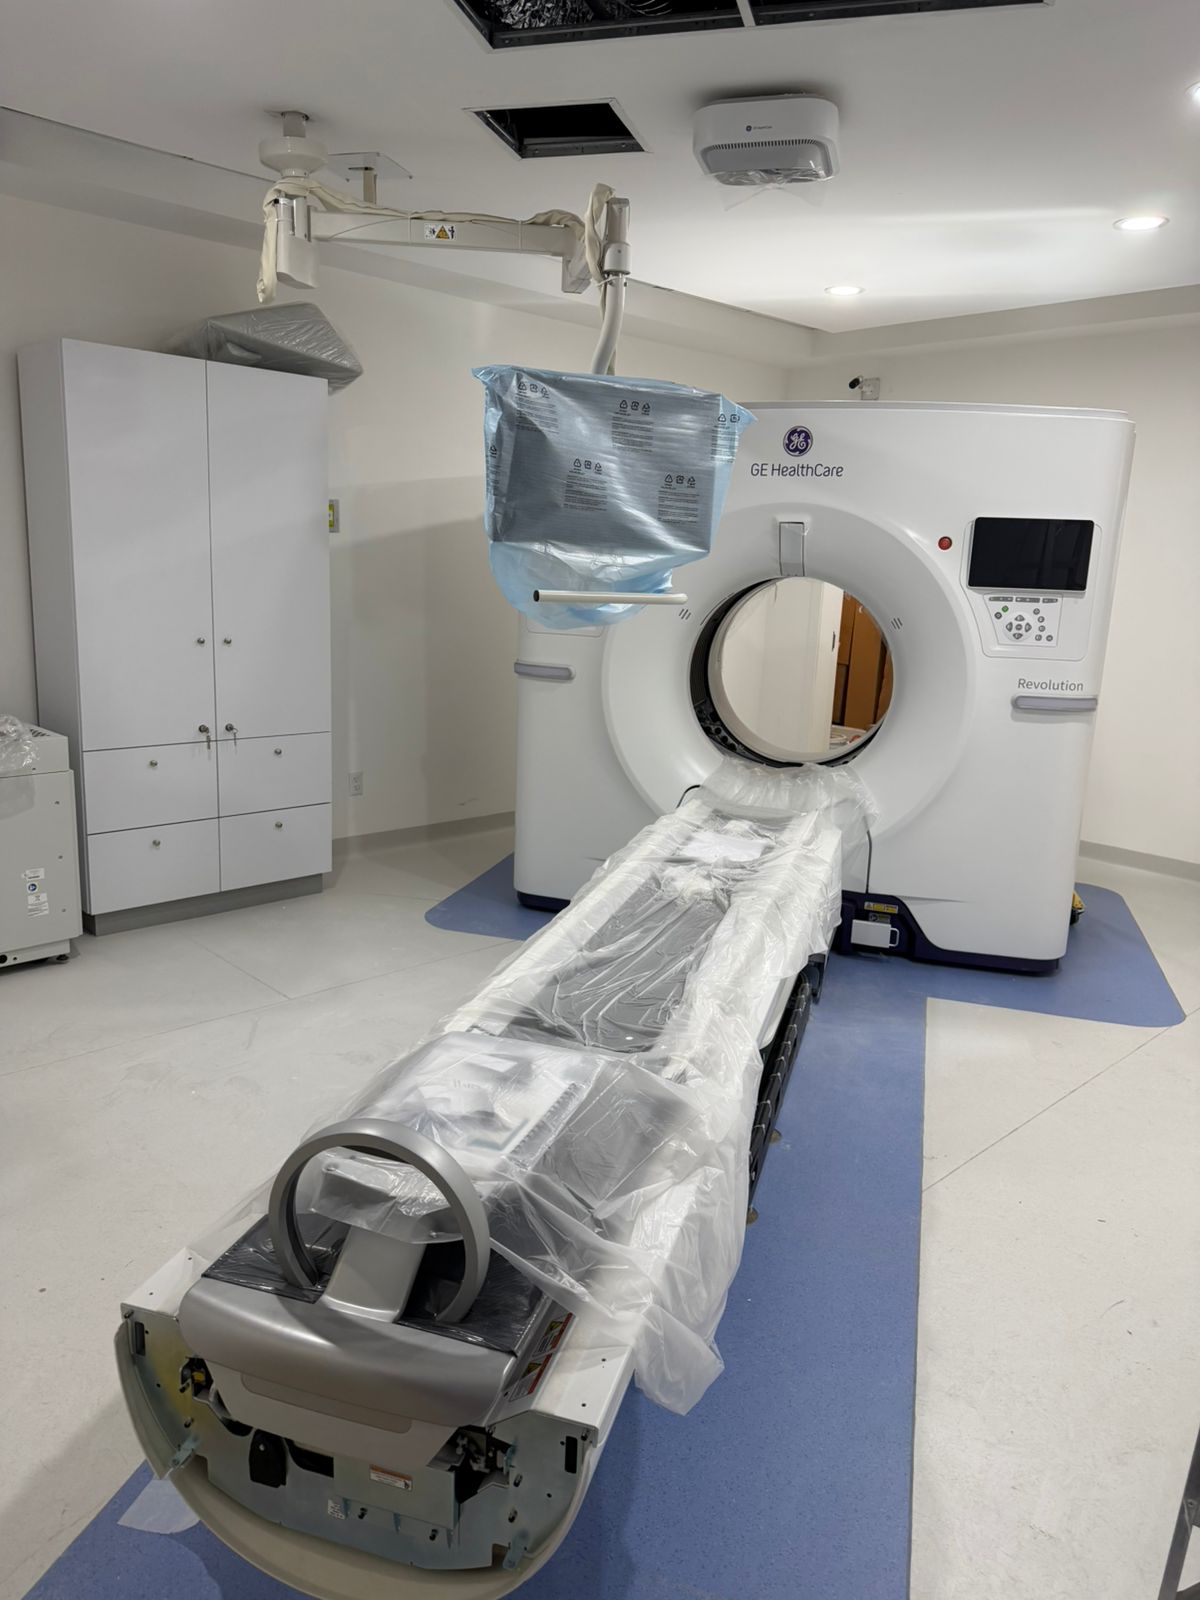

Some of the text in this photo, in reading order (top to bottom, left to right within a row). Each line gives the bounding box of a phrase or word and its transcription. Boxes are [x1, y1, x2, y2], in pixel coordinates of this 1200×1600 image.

[750, 462, 844, 478] GE HealthCare
[1017, 678, 1084, 692] Revolution
